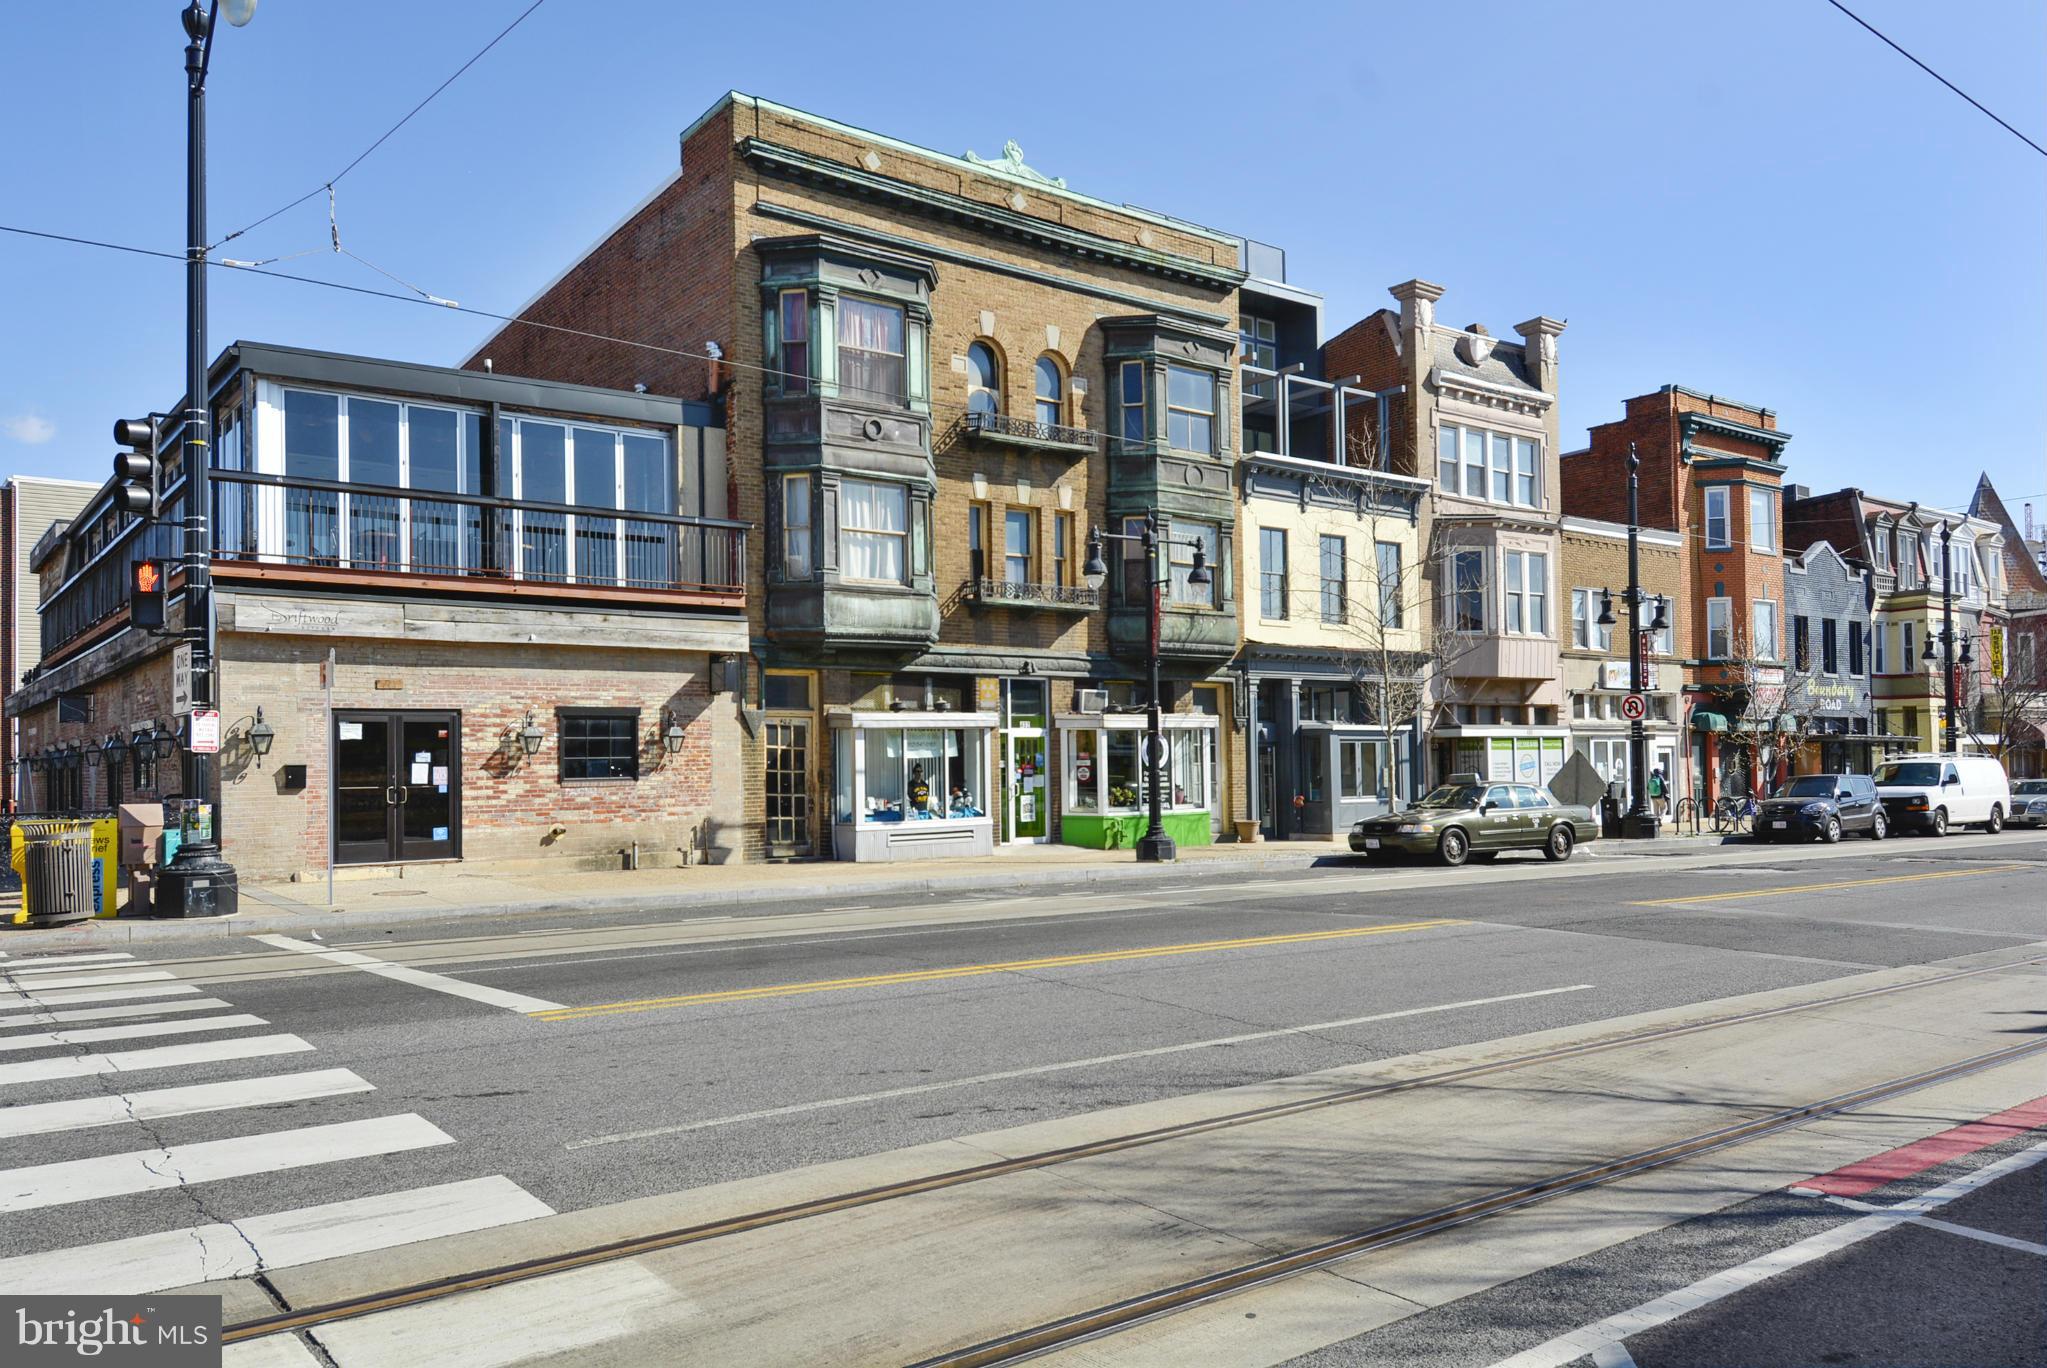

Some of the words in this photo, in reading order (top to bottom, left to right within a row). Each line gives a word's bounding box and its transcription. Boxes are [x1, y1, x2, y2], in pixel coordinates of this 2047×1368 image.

[260, 602, 345, 626] Driftwood
[176, 652, 188, 669] ONE
[176, 670, 188, 688] WAY
[1807, 679, 1854, 702] Boundary
[1820, 698, 1842, 710] ROAD
